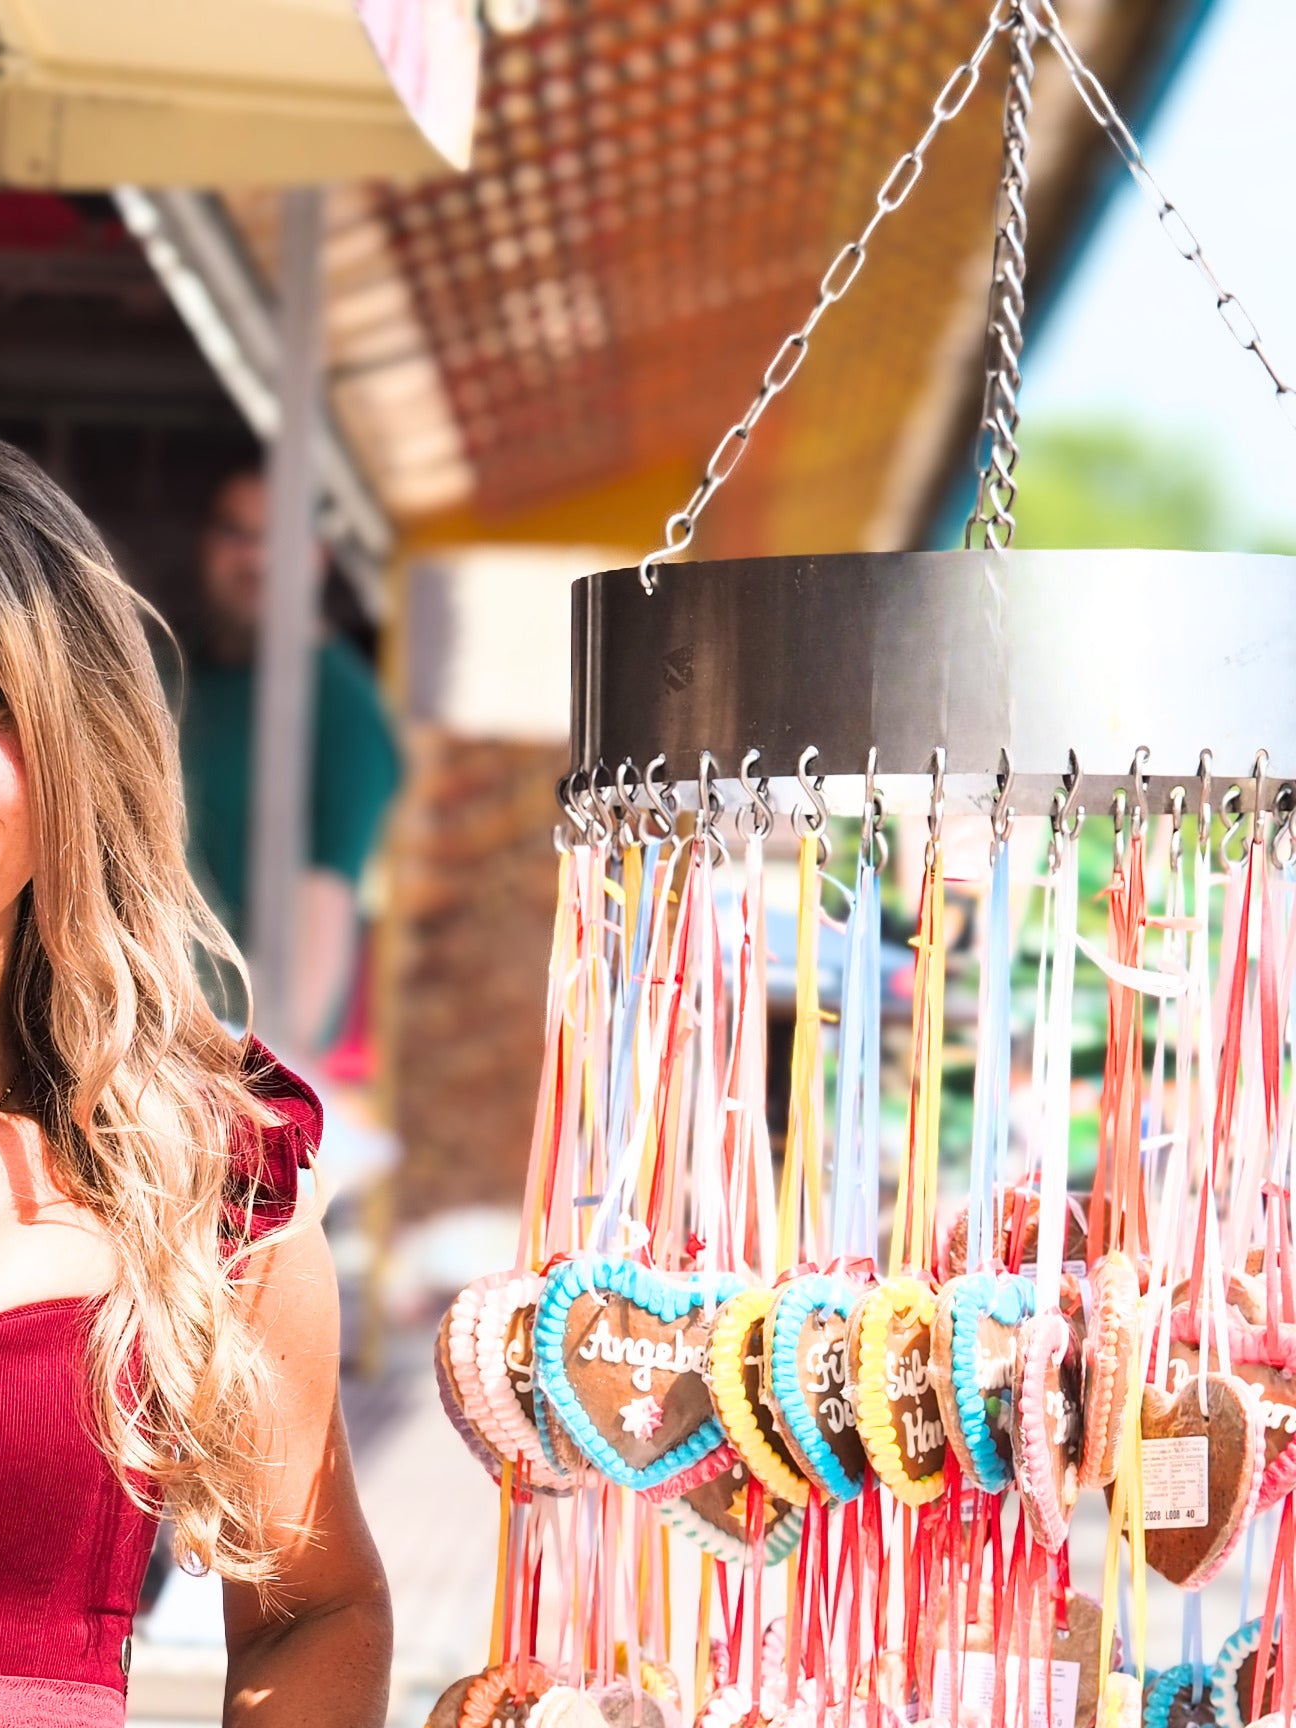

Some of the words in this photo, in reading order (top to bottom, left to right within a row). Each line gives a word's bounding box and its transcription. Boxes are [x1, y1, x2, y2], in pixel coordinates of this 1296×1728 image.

[579, 1320, 705, 1392] Angebe
[886, 1348, 930, 1405] Süß
[1145, 1511, 1161, 1520] 2028
[1186, 1509, 1195, 1518] 40
